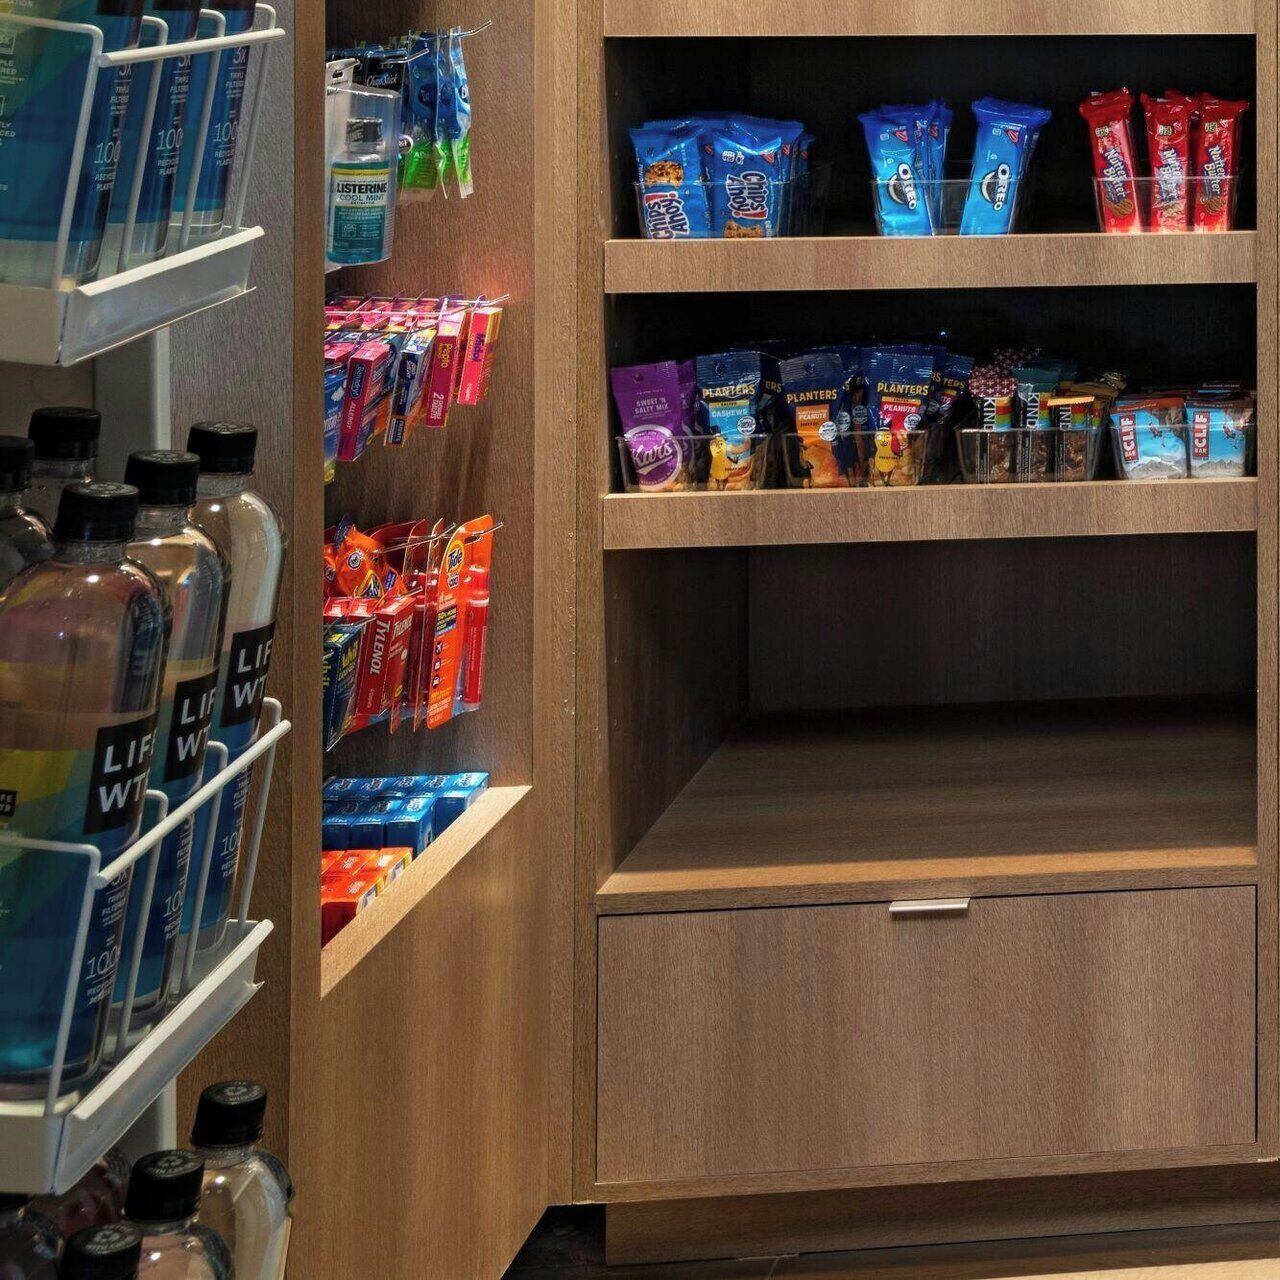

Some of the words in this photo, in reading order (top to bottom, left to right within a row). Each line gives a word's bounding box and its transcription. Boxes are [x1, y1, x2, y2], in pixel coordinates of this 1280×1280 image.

[1104, 146, 1128, 180] Nutter
[1204, 163, 1221, 194] Butter
[1208, 144, 1227, 179] Nutter
[336, 182, 388, 194] LISTERINE
[739, 171, 768, 212] Chips
[897, 161, 917, 210] OREO
[993, 163, 1010, 212] OREO
[1103, 166, 1126, 198] Butter
[648, 200, 675, 239] Chips
[636, 397, 659, 407] SWEET
[702, 383, 756, 399] PLANTERS
[786, 389, 838, 404] PLANTERS
[876, 382, 929, 396] PLANTERS
[634, 405, 655, 415] SALTY
[711, 408, 749, 418] CASHEWS
[883, 404, 917, 414] PEANUTS
[984, 397, 996, 431] KIND
[1026, 392, 1040, 429] KIND
[1059, 407, 1071, 430] IND
[1120, 416, 1137, 451] CLIF
[1194, 411, 1209, 447] CLIF
[447, 547, 463, 573] Tide
[237, 638, 272, 672] LIF
[370, 619, 391, 676] TYLENOL
[181, 686, 216, 725] LIF
[233, 674, 267, 708] WT
[104, 734, 153, 774] LIF
[176, 727, 211, 762] WT
[99, 774, 146, 813] WT
